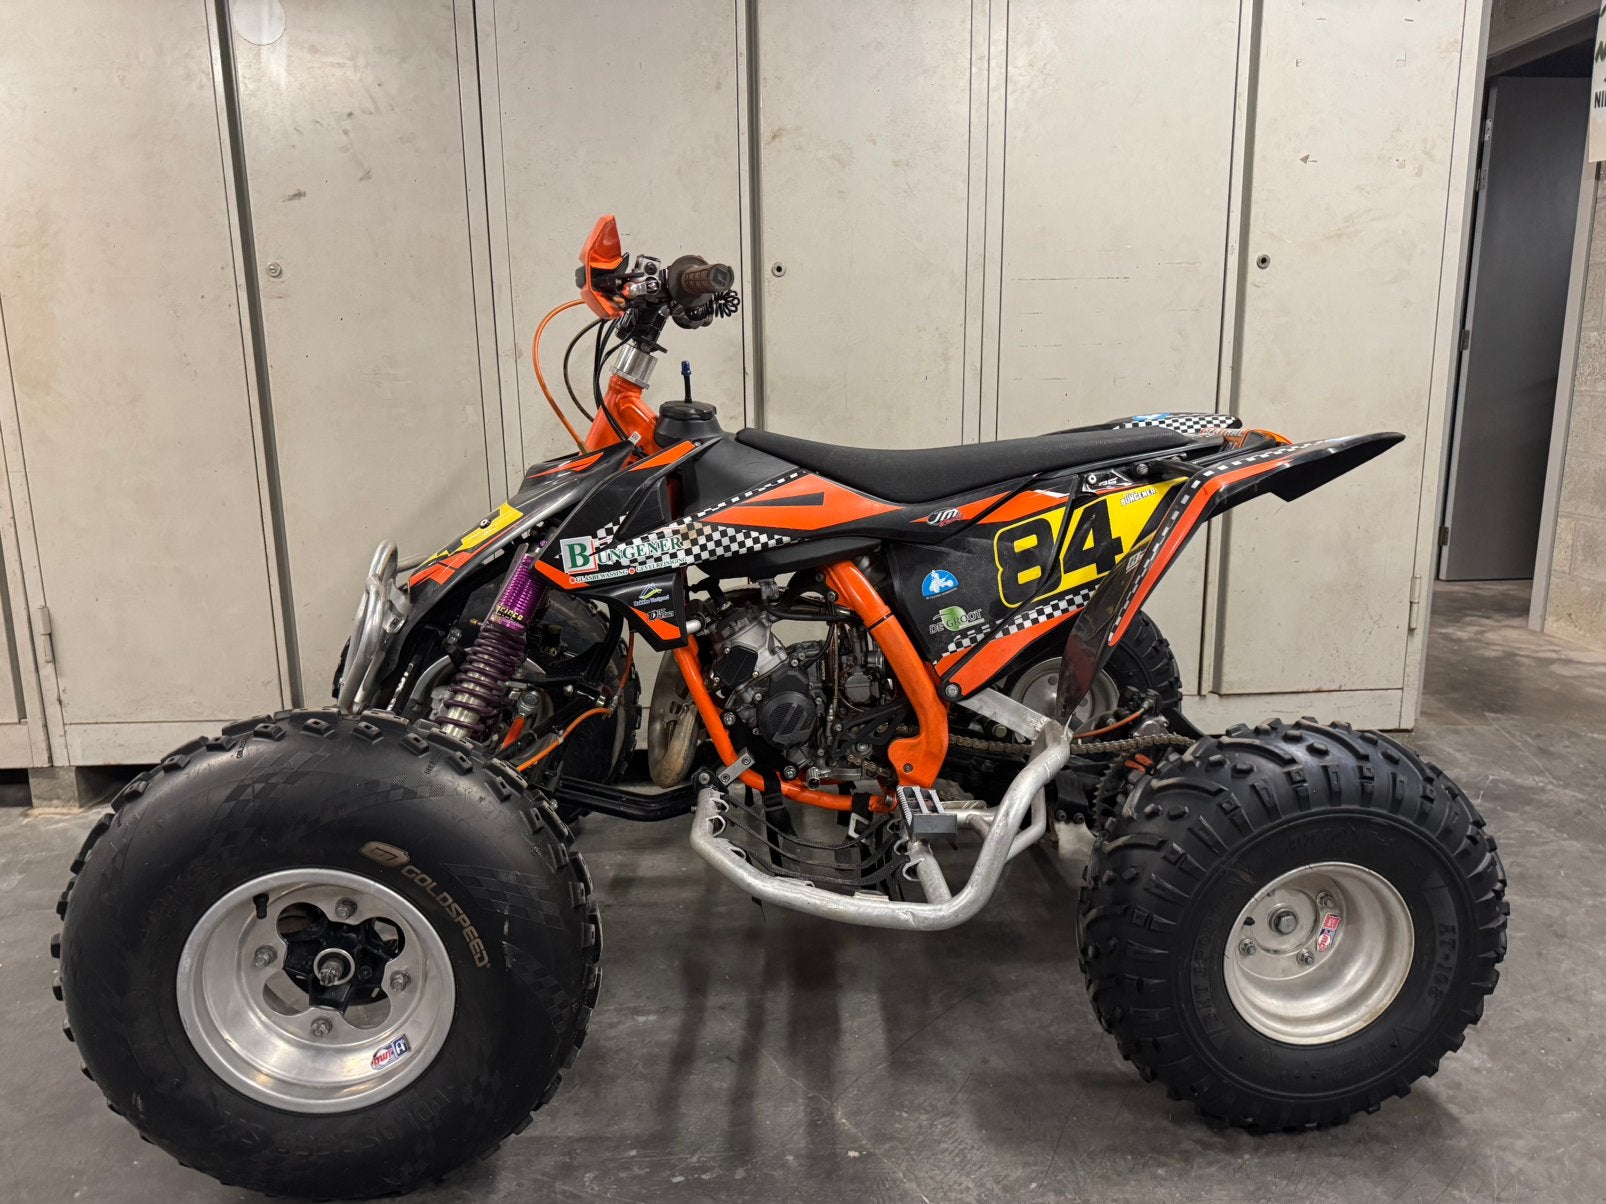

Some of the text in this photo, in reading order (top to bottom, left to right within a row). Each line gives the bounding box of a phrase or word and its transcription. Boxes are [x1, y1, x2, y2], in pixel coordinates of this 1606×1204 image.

[567, 537, 684, 569] BUNGENER
[994, 498, 1124, 607] 84
[928, 608, 983, 635] DE GROOT
[401, 864, 490, 969] GOLDSPEED
